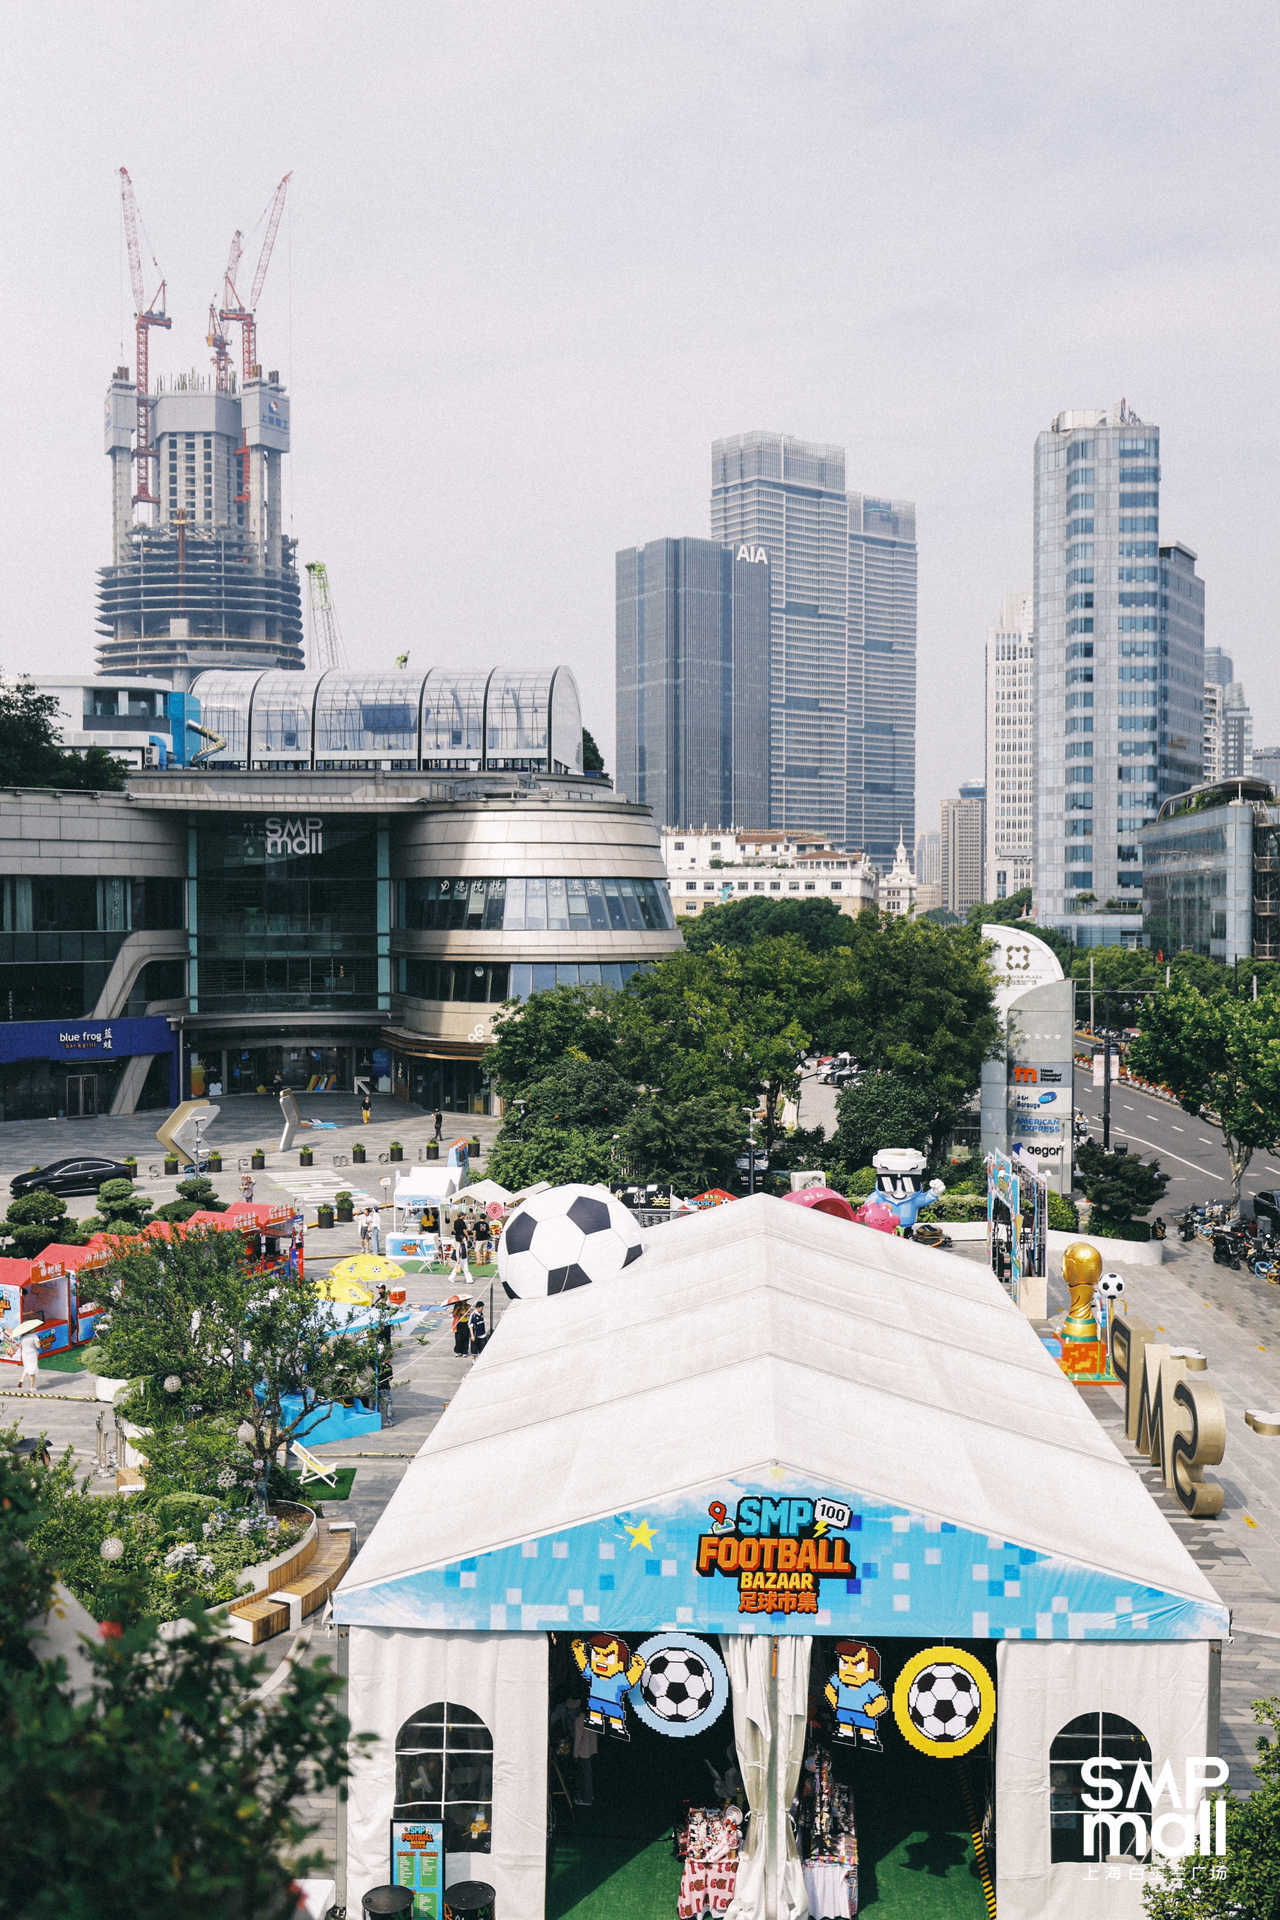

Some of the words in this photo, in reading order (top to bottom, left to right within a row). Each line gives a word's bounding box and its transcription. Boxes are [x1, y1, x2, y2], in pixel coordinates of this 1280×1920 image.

[736, 544, 768, 565] AIA
[265, 817, 323, 838] SMP
[266, 832, 323, 855] mall
[59, 1032, 80, 1042] blue
[82, 1032, 102, 1042] frog
[1016, 1117, 1060, 1126] AMERICAN
[1021, 1125, 1061, 1134] EXPRESS
[737, 1497, 815, 1537] SMP
[820, 1503, 846, 1522] 100
[697, 1536, 853, 1575] FOOTBALL
[739, 1571, 816, 1592] BAZAAR
[739, 1591, 819, 1614] 足球市集
